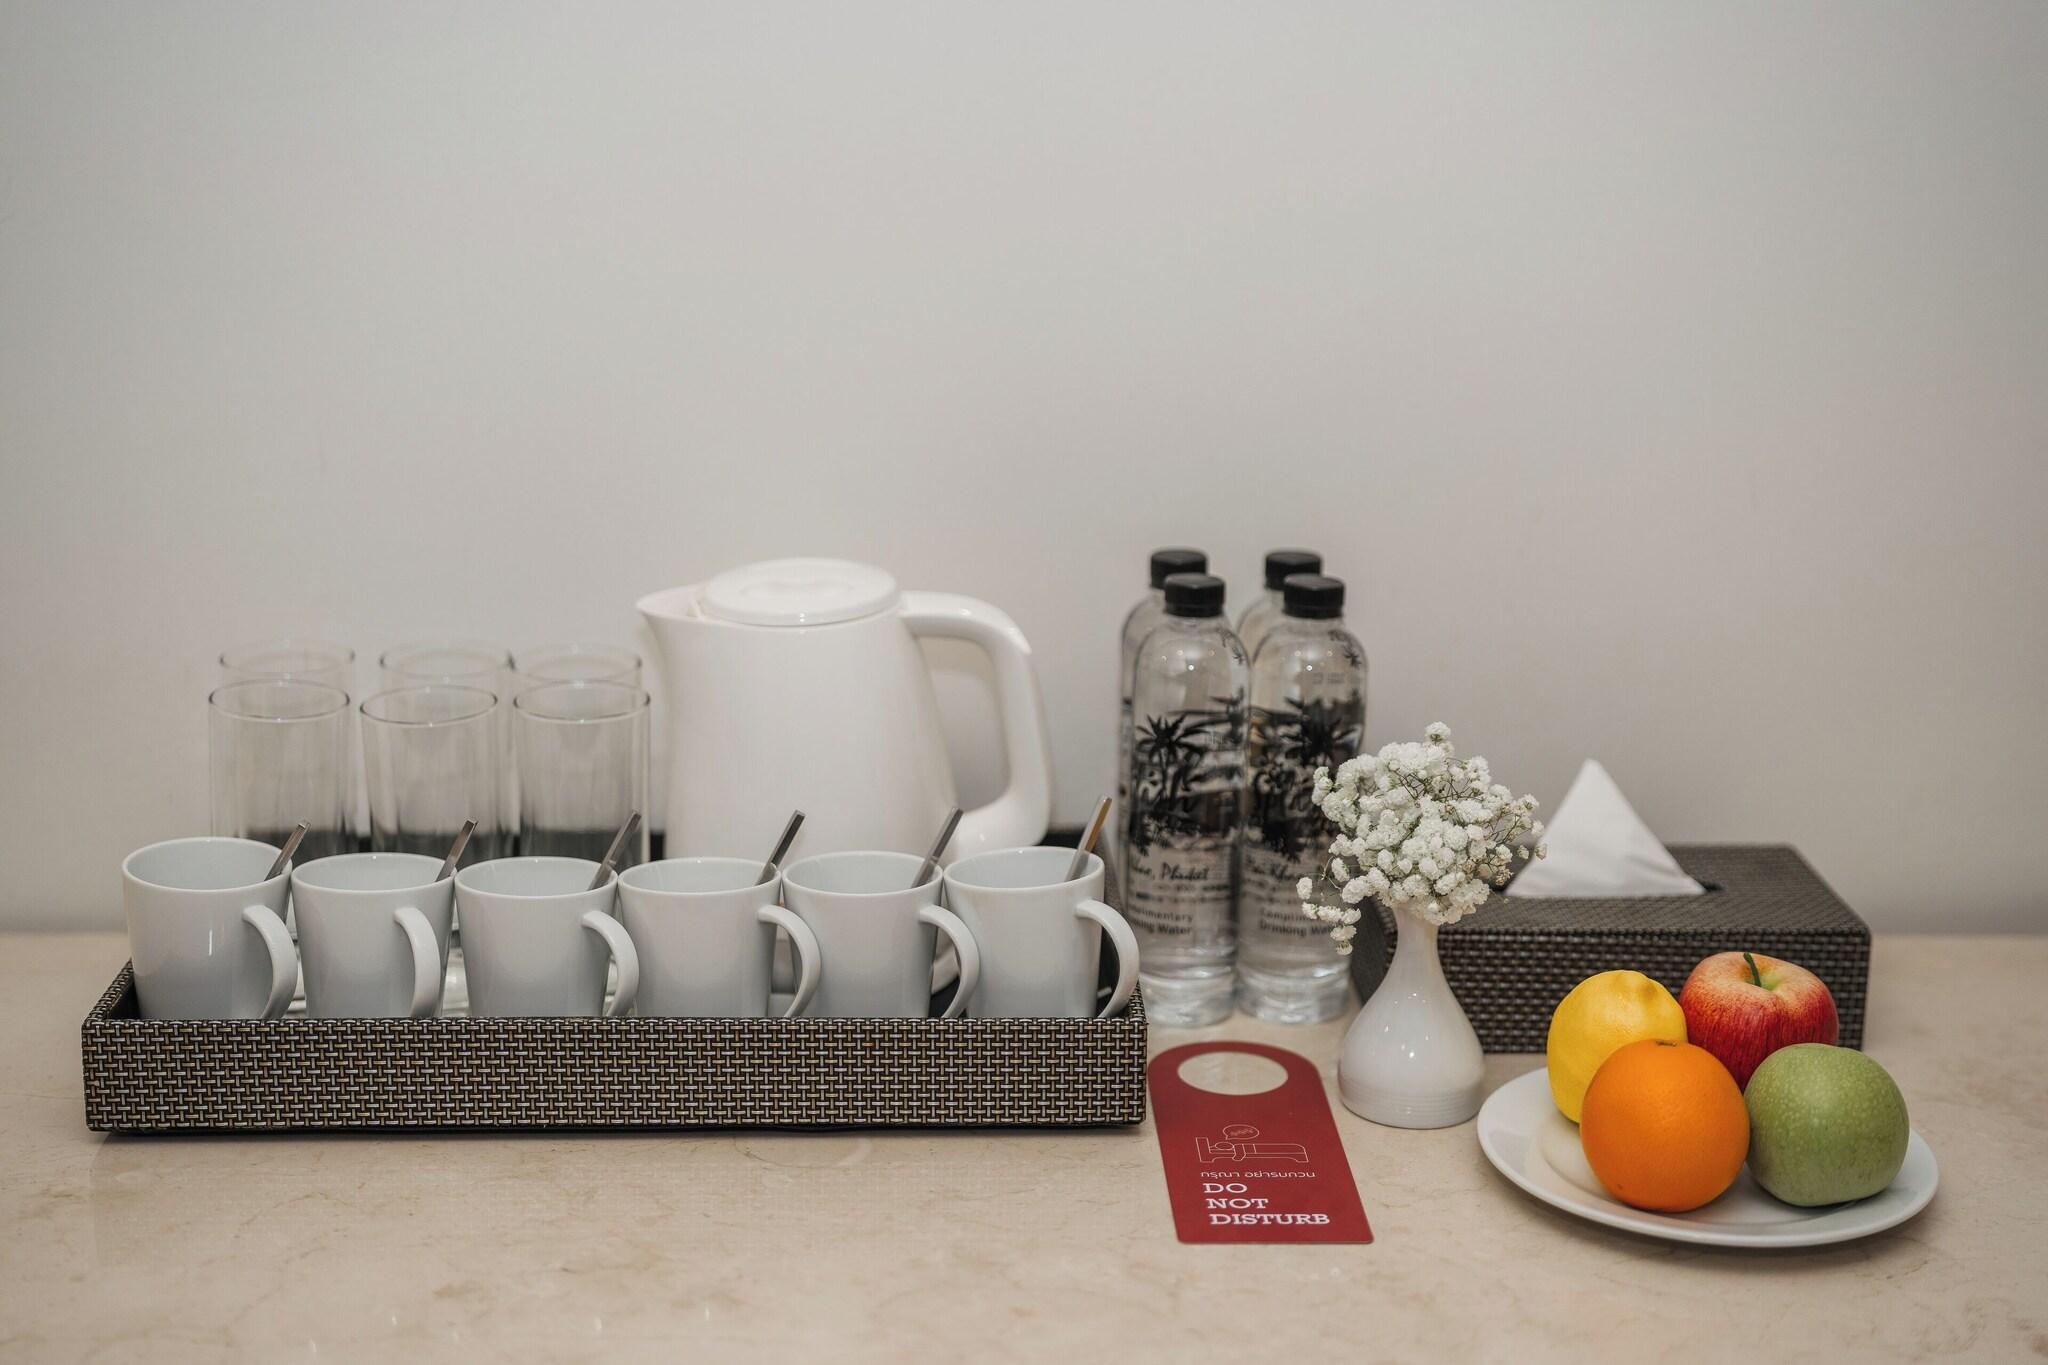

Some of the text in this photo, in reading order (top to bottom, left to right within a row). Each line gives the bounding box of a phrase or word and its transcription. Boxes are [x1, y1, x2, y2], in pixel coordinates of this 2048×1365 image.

[1202, 1182, 1248, 1194] DO
[1205, 1198, 1269, 1209] NOT
[1209, 1213, 1331, 1225] DISTURB
